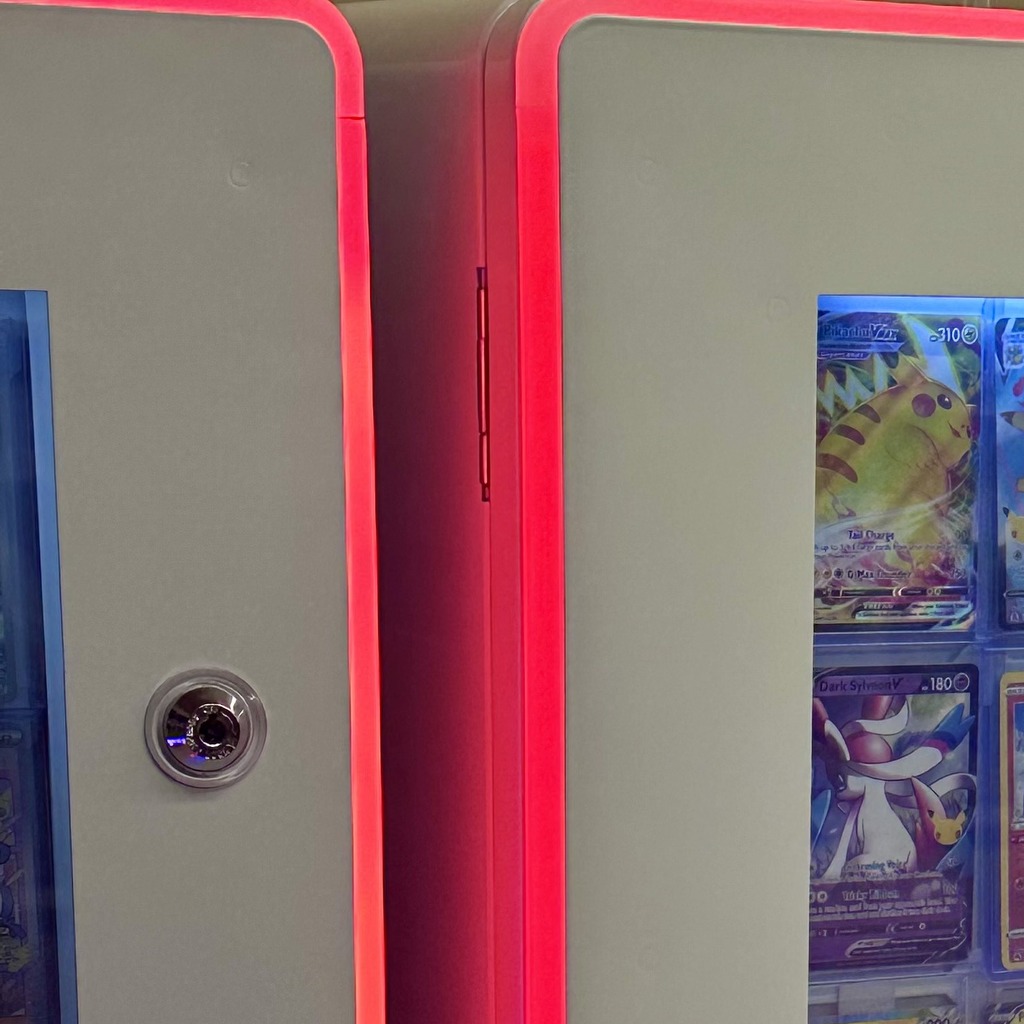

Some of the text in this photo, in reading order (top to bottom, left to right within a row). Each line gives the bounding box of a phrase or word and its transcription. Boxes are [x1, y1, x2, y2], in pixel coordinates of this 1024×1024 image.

[938, 326, 960, 342] 310
[819, 680, 848, 692] Dark
[930, 676, 952, 691] 180
